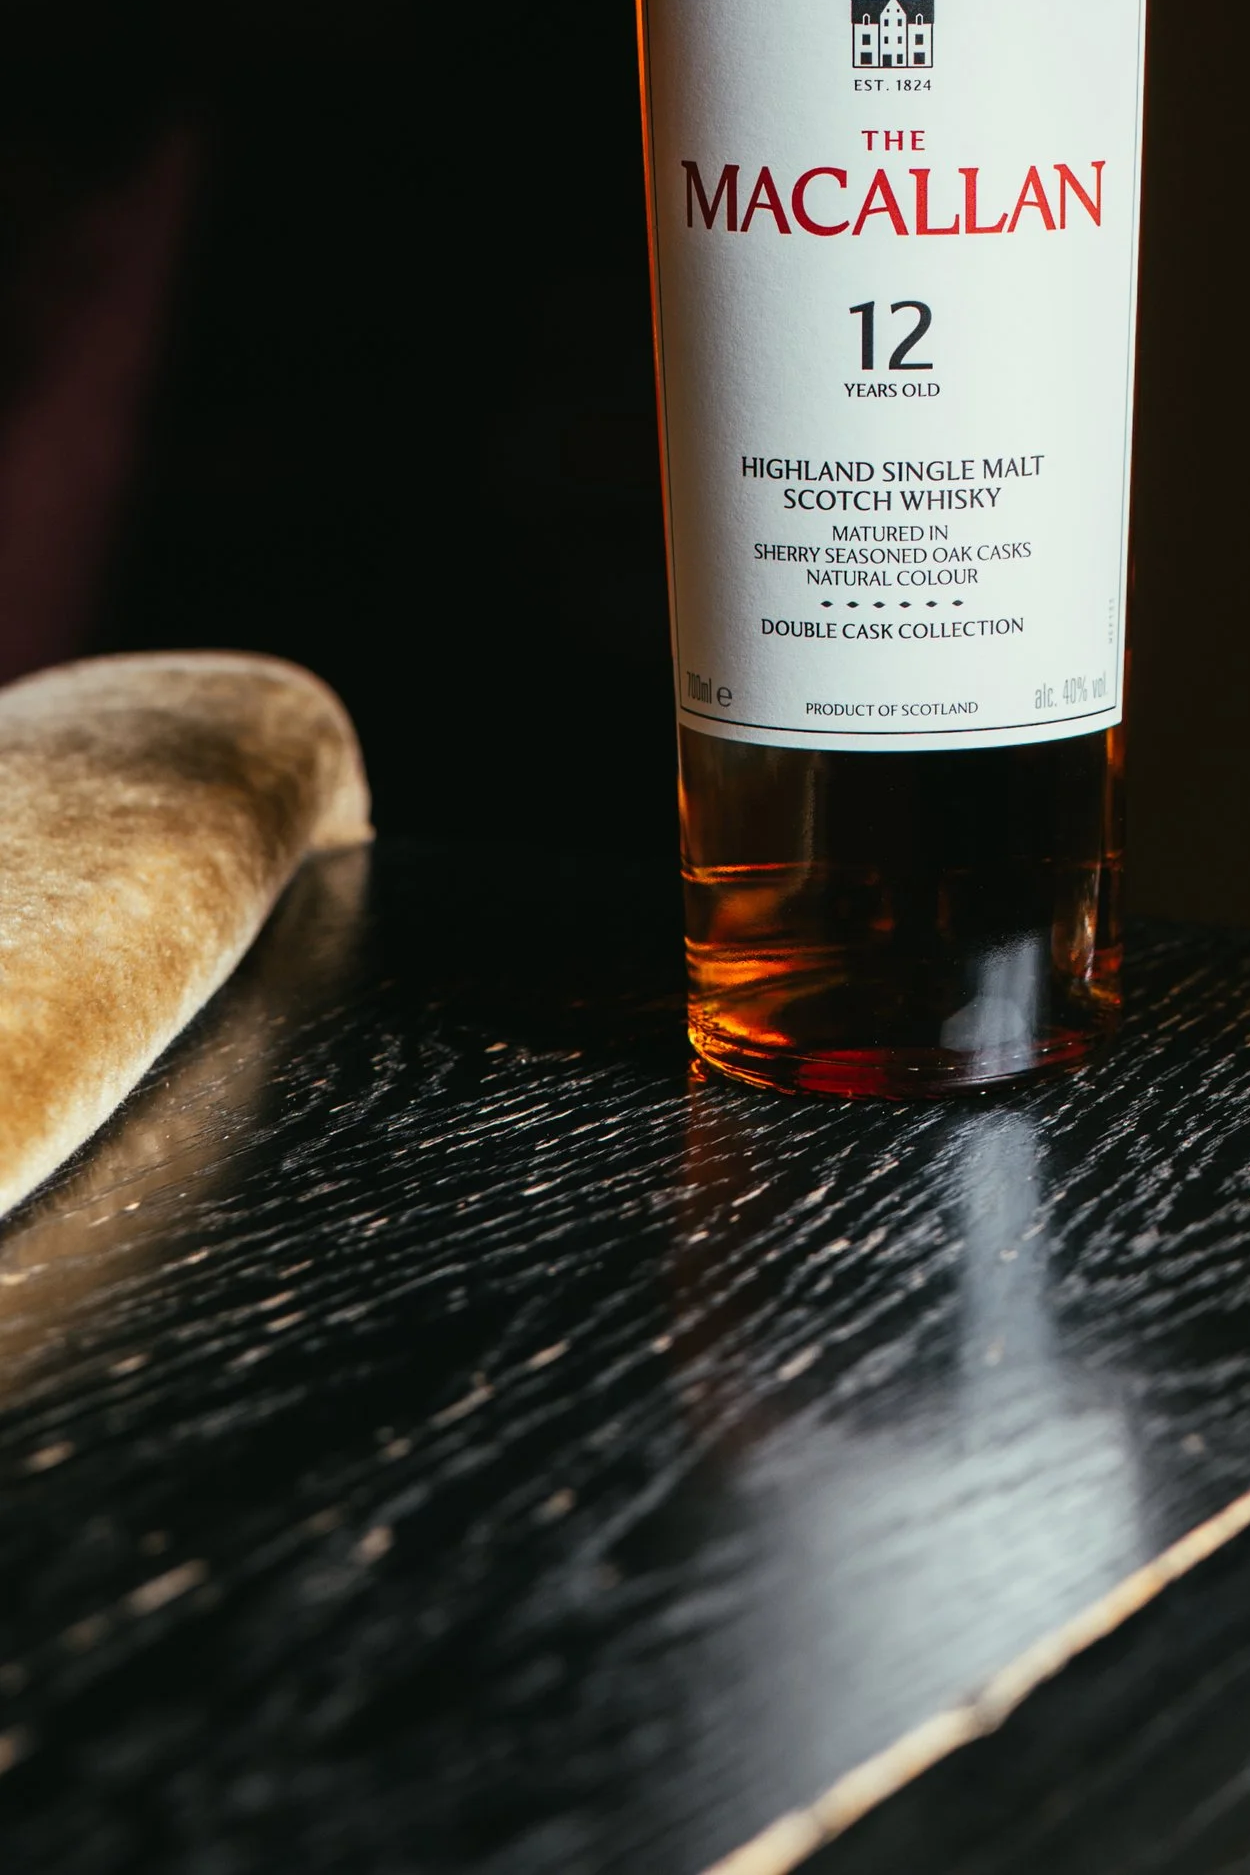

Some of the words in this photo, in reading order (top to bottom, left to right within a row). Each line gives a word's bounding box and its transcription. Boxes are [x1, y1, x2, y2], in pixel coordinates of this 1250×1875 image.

[854, 80, 889, 91] EST.
[896, 80, 931, 91] 1824
[861, 130, 925, 151] THE
[681, 160, 1106, 237] MACALLAN
[849, 301, 933, 370] 12
[844, 383, 897, 397] YEARS
[902, 383, 940, 397] OLD
[742, 456, 874, 482] HIGHLAND
[883, 460, 974, 482] SINGLE
[983, 455, 1044, 479] MALT
[784, 488, 892, 511] SCOTCH
[900, 488, 1001, 510] WHISKY
[832, 526, 924, 542] MATURED
[930, 525, 947, 540] IN
[754, 543, 821, 563] SHERRY
[825, 548, 927, 564] SEASONED
[933, 546, 972, 563] OAK
[977, 542, 1031, 560] CASKS
[807, 569, 892, 586] NATURAL
[897, 569, 978, 586] COLOUR
[761, 619, 837, 638] DOUBLE
[842, 624, 893, 639] CASK
[898, 618, 1023, 639] COLLECTION
[687, 671, 712, 705] 700ml
[1035, 683, 1057, 709] alc.
[1063, 676, 1087, 705] 40%
[806, 703, 874, 716] PRODUCT
[878, 705, 897, 716] OF
[902, 702, 978, 716] SCOTLAND
